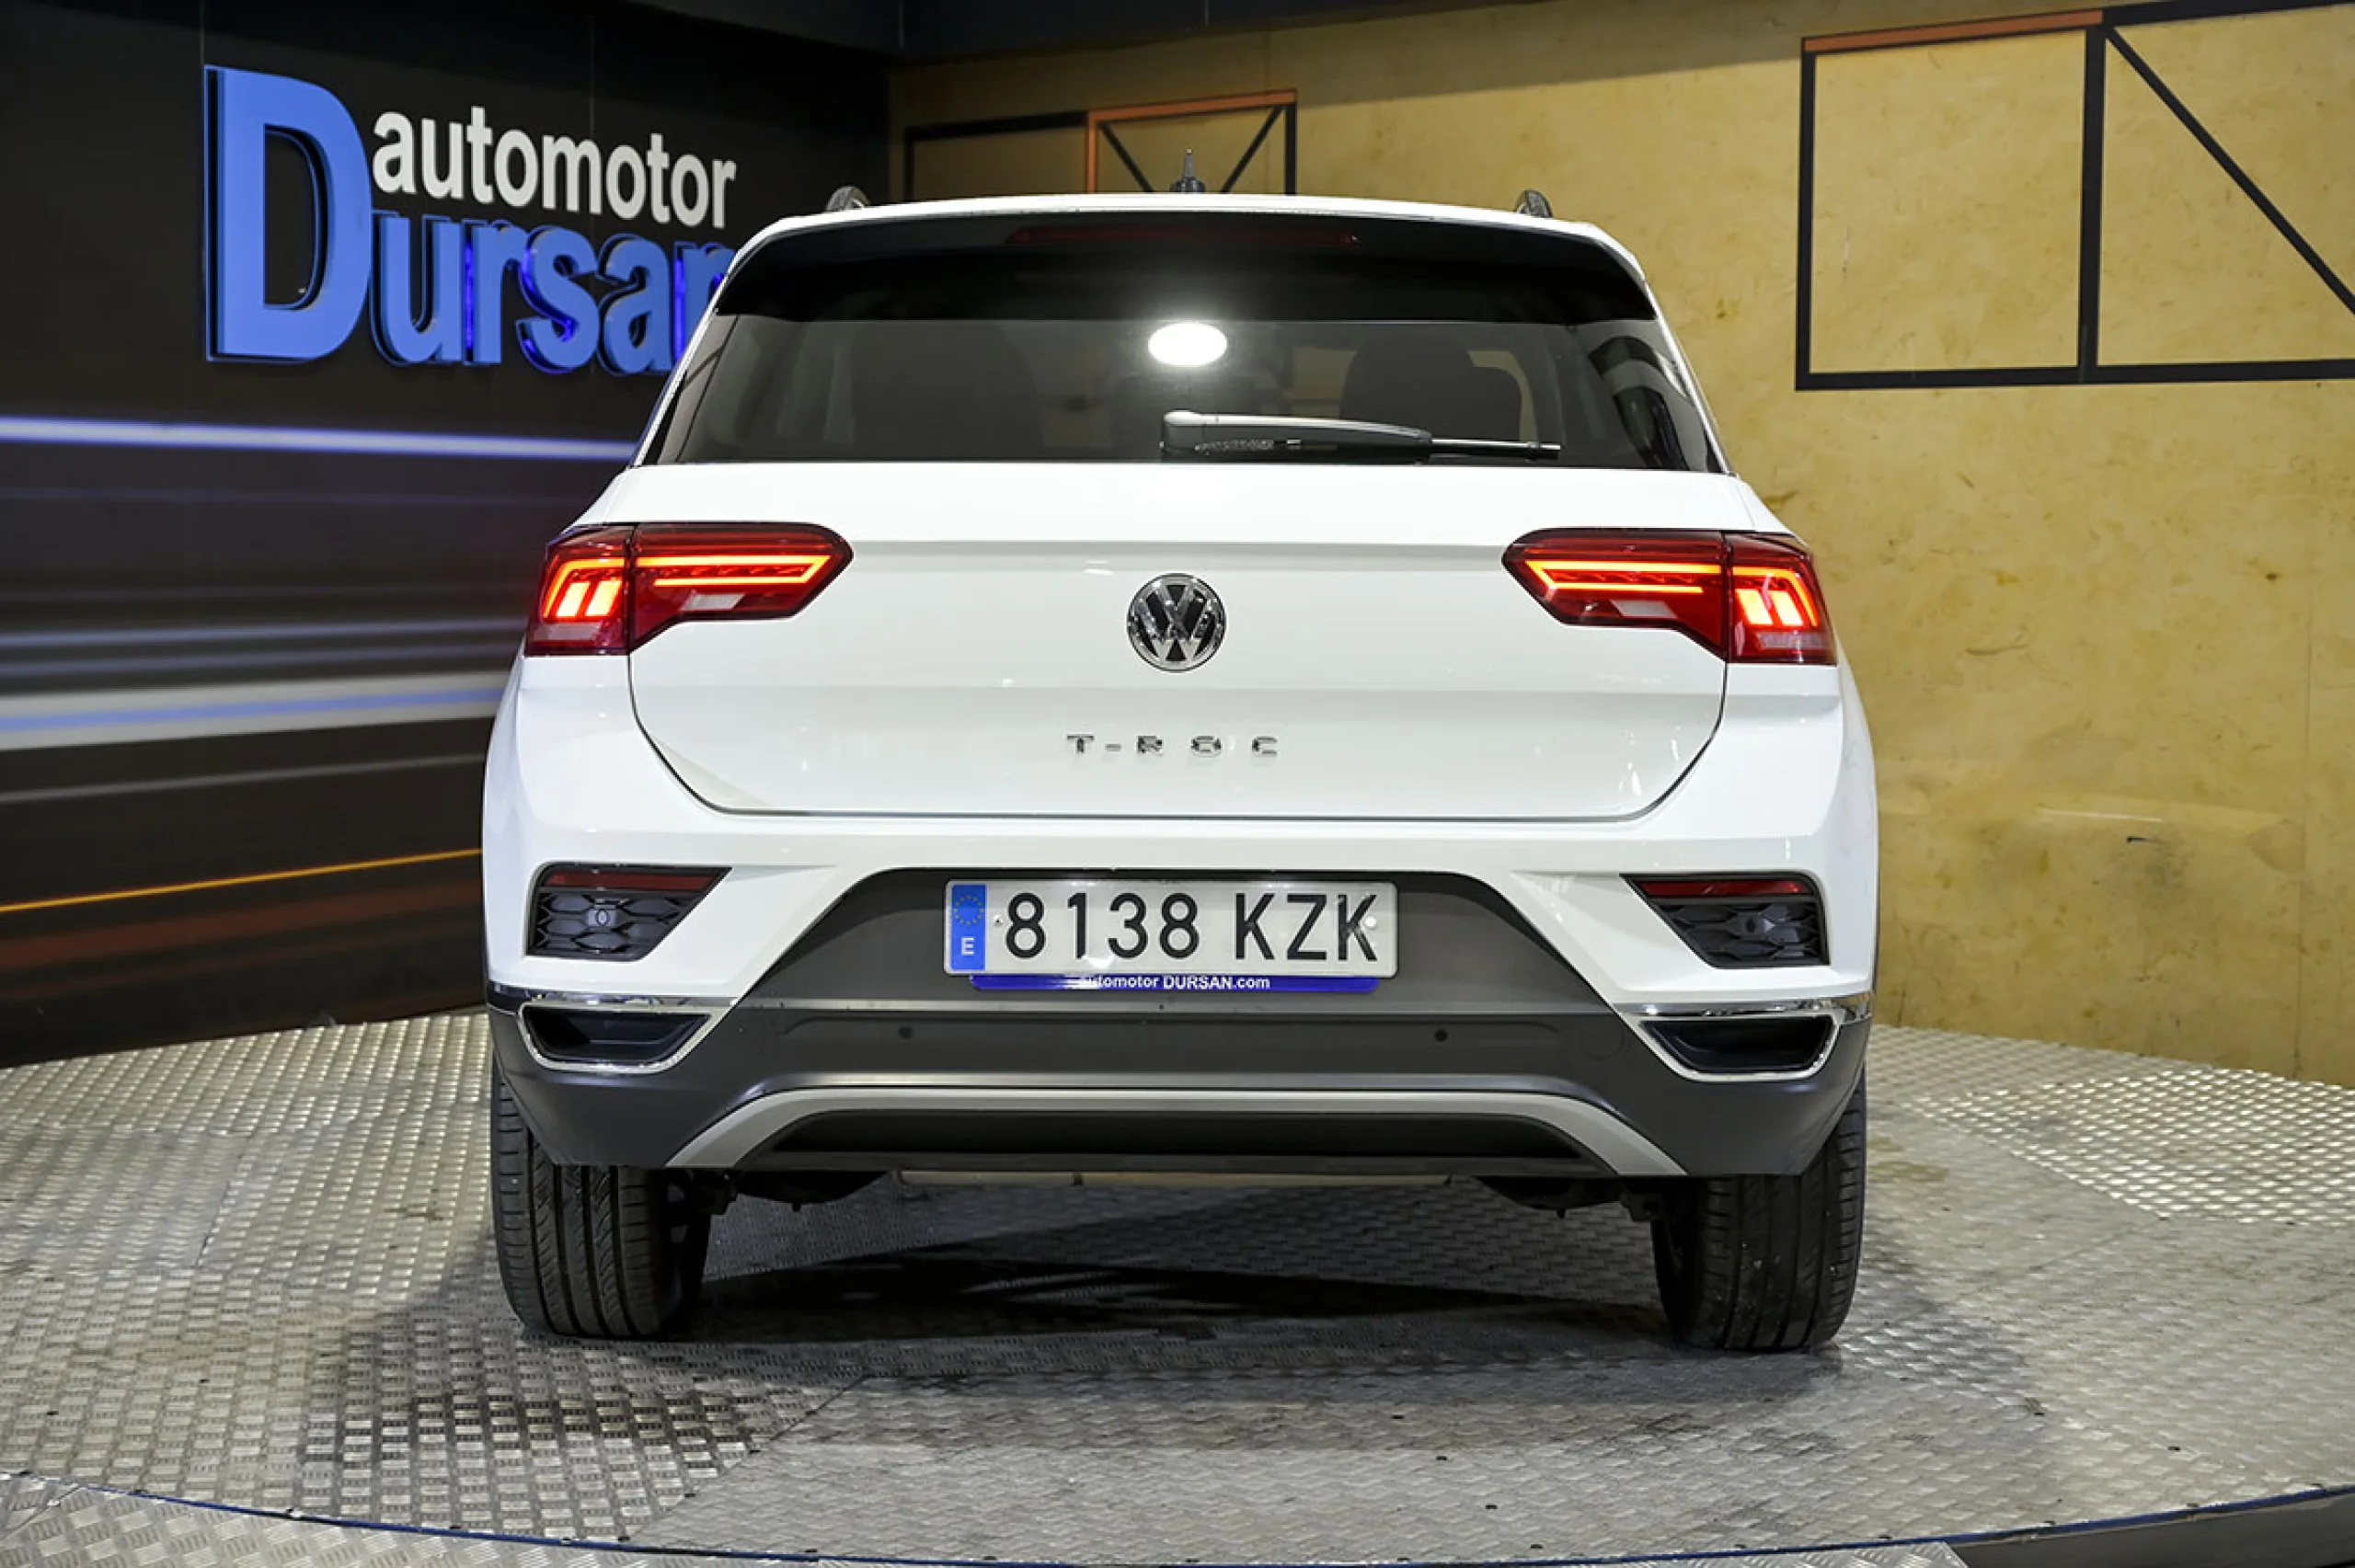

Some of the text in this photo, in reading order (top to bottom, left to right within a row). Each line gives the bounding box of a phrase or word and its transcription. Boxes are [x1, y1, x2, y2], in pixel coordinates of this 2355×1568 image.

[372, 105, 736, 229] automotor
[1066, 733, 1280, 757] T-ROC
[1005, 891, 1379, 962] 8138 KZK
[960, 936, 975, 956] E
[1080, 976, 1271, 990] tomotor DURSAN.com
